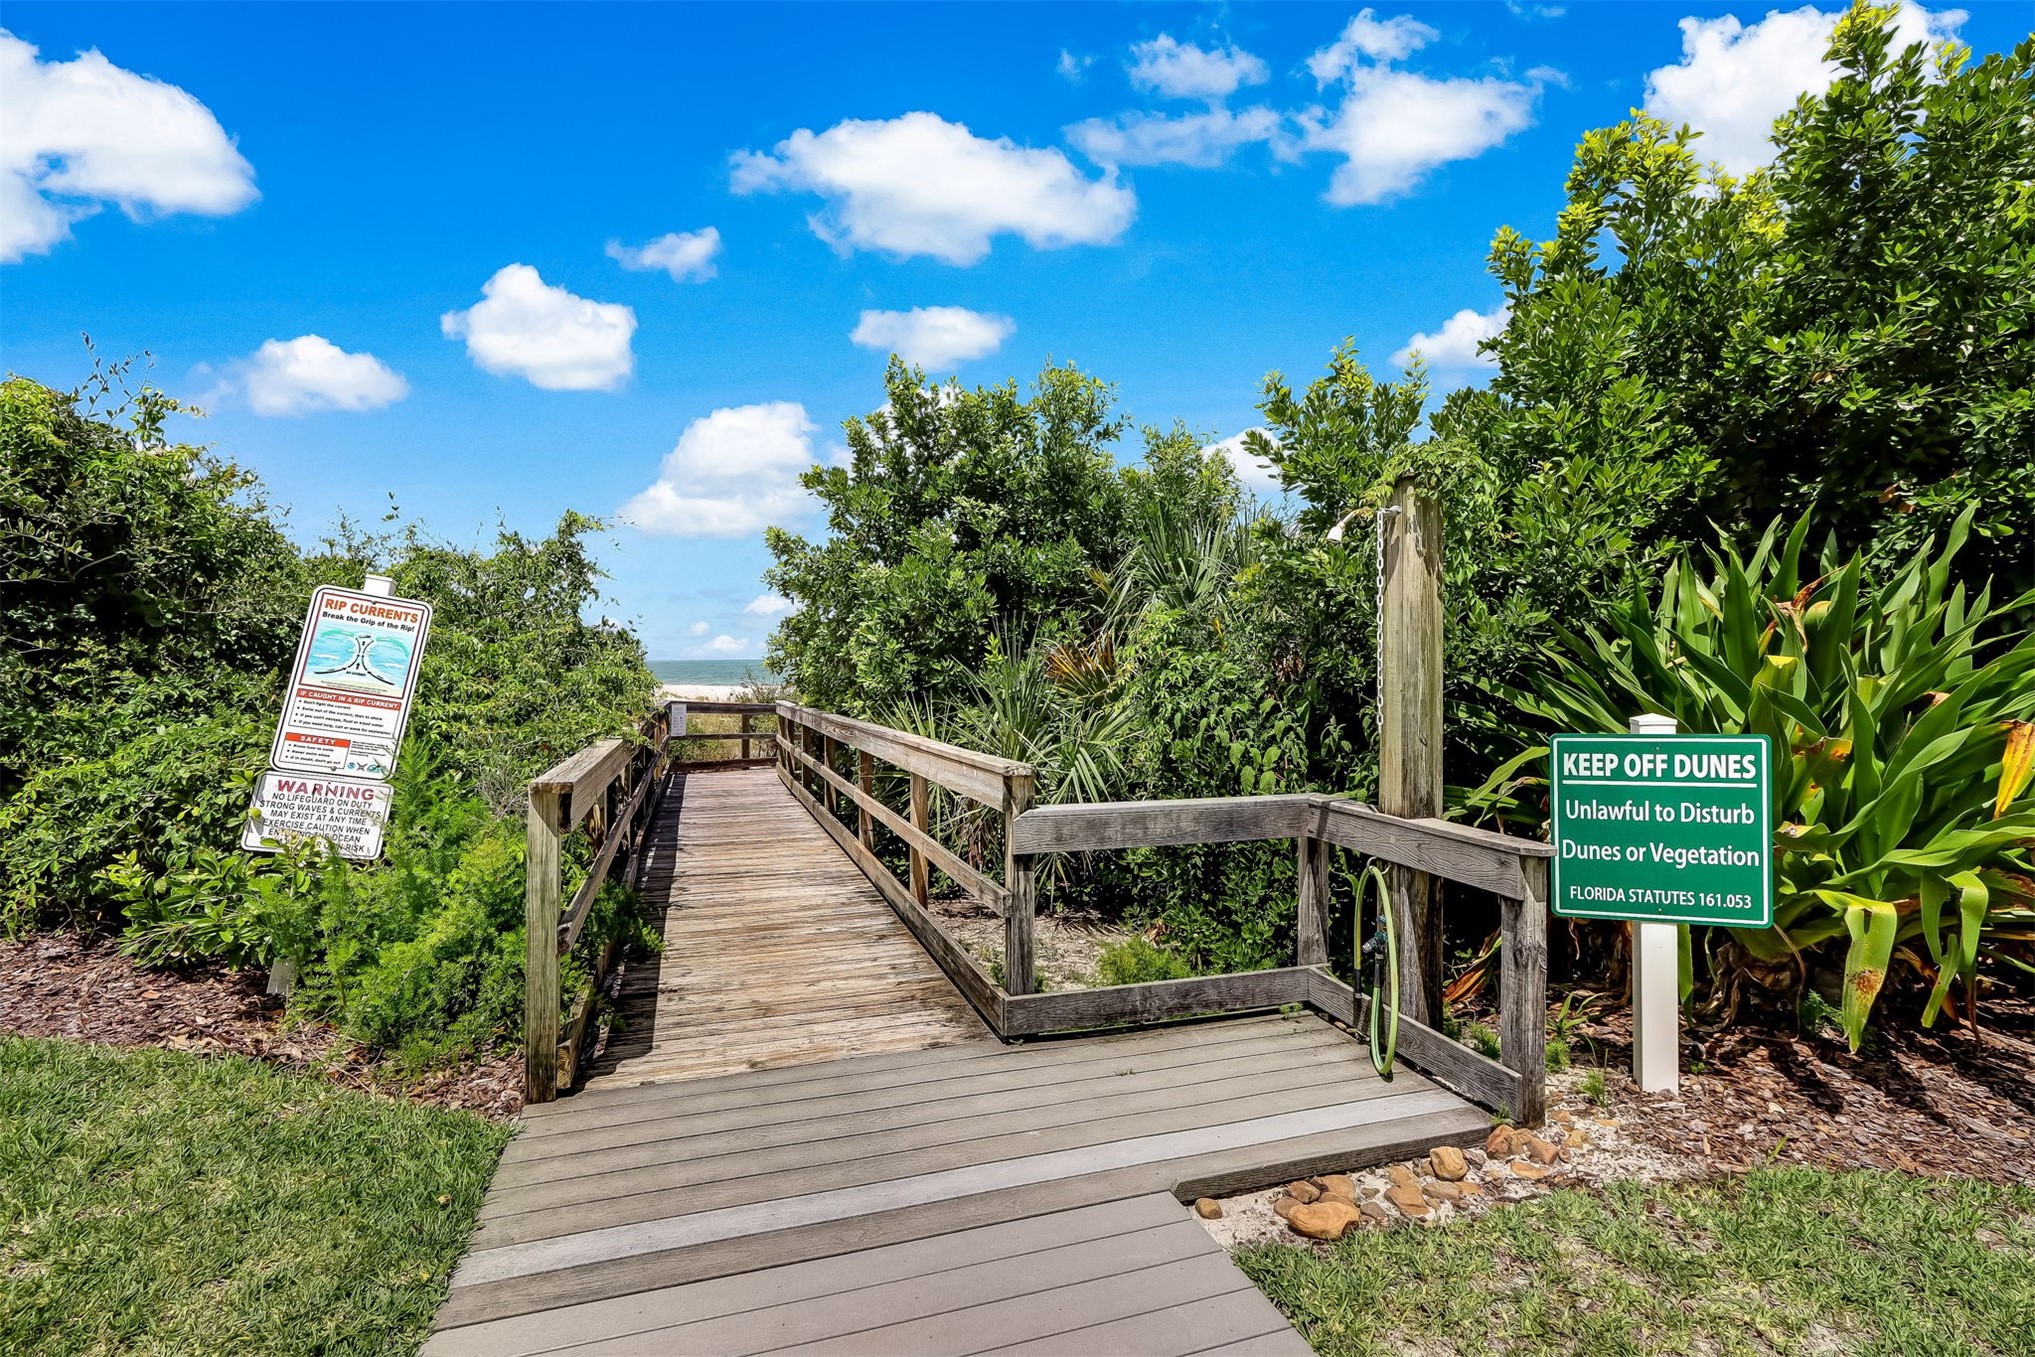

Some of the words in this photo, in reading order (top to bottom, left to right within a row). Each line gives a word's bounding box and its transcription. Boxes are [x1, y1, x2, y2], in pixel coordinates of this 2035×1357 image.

[324, 598, 347, 611] RIP
[350, 603, 419, 624] CURRENTS
[322, 611, 344, 620] Break
[360, 618, 376, 627] Grip
[400, 624, 414, 632] Rip!
[308, 691, 336, 700] CAUGHT
[366, 700, 398, 708] CURRENT
[300, 736, 336, 745] SAFETY
[1563, 753, 1619, 776] KEEP
[1624, 754, 1668, 778] OFF
[1674, 754, 1756, 779] DUNES
[277, 779, 375, 800] WARNING
[259, 800, 295, 810] STRONG
[297, 804, 326, 814] WAVES
[329, 806, 335, 814] &
[337, 808, 382, 818] CURRENTS
[272, 792, 286, 801] NO
[286, 794, 334, 806] LIFEGUARD
[350, 801, 372, 809] DUTY
[270, 810, 288, 818] MAY
[290, 812, 314, 820] EXIST
[328, 816, 346, 824] ANY
[348, 817, 367, 826] TIME
[1565, 800, 1650, 822] Unlawful
[1654, 804, 1676, 822] to
[1680, 802, 1755, 824] Disturb
[262, 818, 304, 830] EXERCISE
[306, 822, 344, 833] CAUTION
[345, 826, 370, 835] WHEN
[332, 833, 360, 843] OCEAN
[345, 844, 365, 852] RISK
[1562, 839, 1621, 861] Dunes
[1626, 846, 1646, 862] or
[1650, 842, 1760, 869] Vegetation
[1570, 886, 1626, 902] FLORIDA
[1628, 888, 1695, 906] STATUTES
[1698, 892, 1752, 909] 161.053
